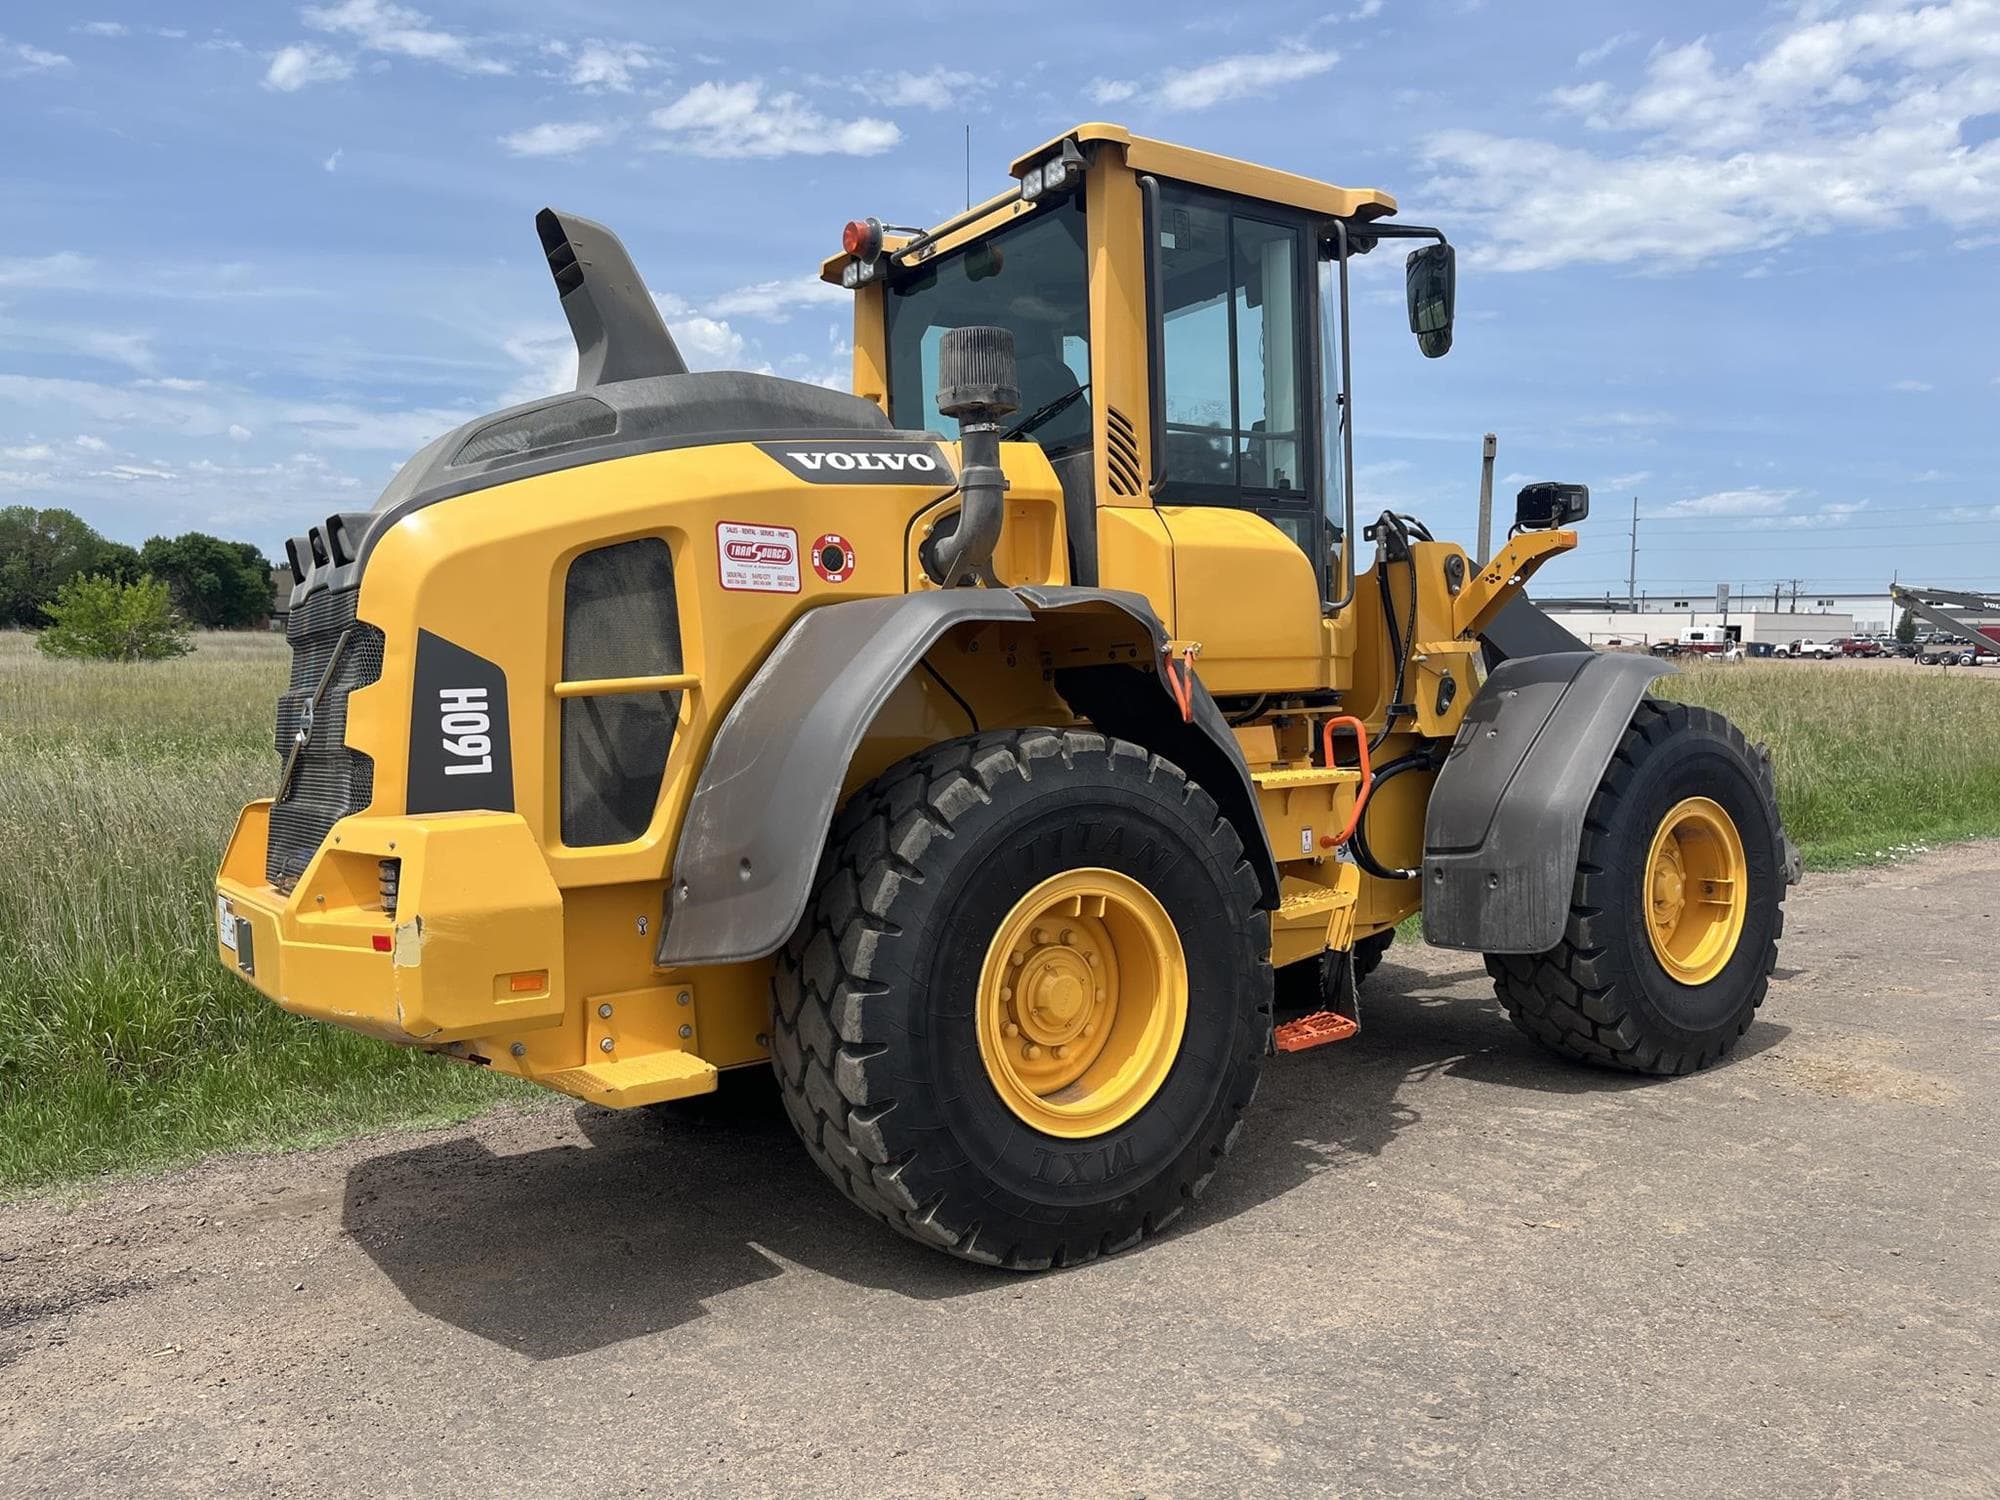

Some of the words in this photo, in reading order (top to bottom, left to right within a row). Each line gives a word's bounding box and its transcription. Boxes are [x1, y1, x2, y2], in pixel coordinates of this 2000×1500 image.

[786, 452, 936, 471] VOLVO
[440, 688, 492, 775] L60H
[1016, 817, 1174, 870] TITAN
